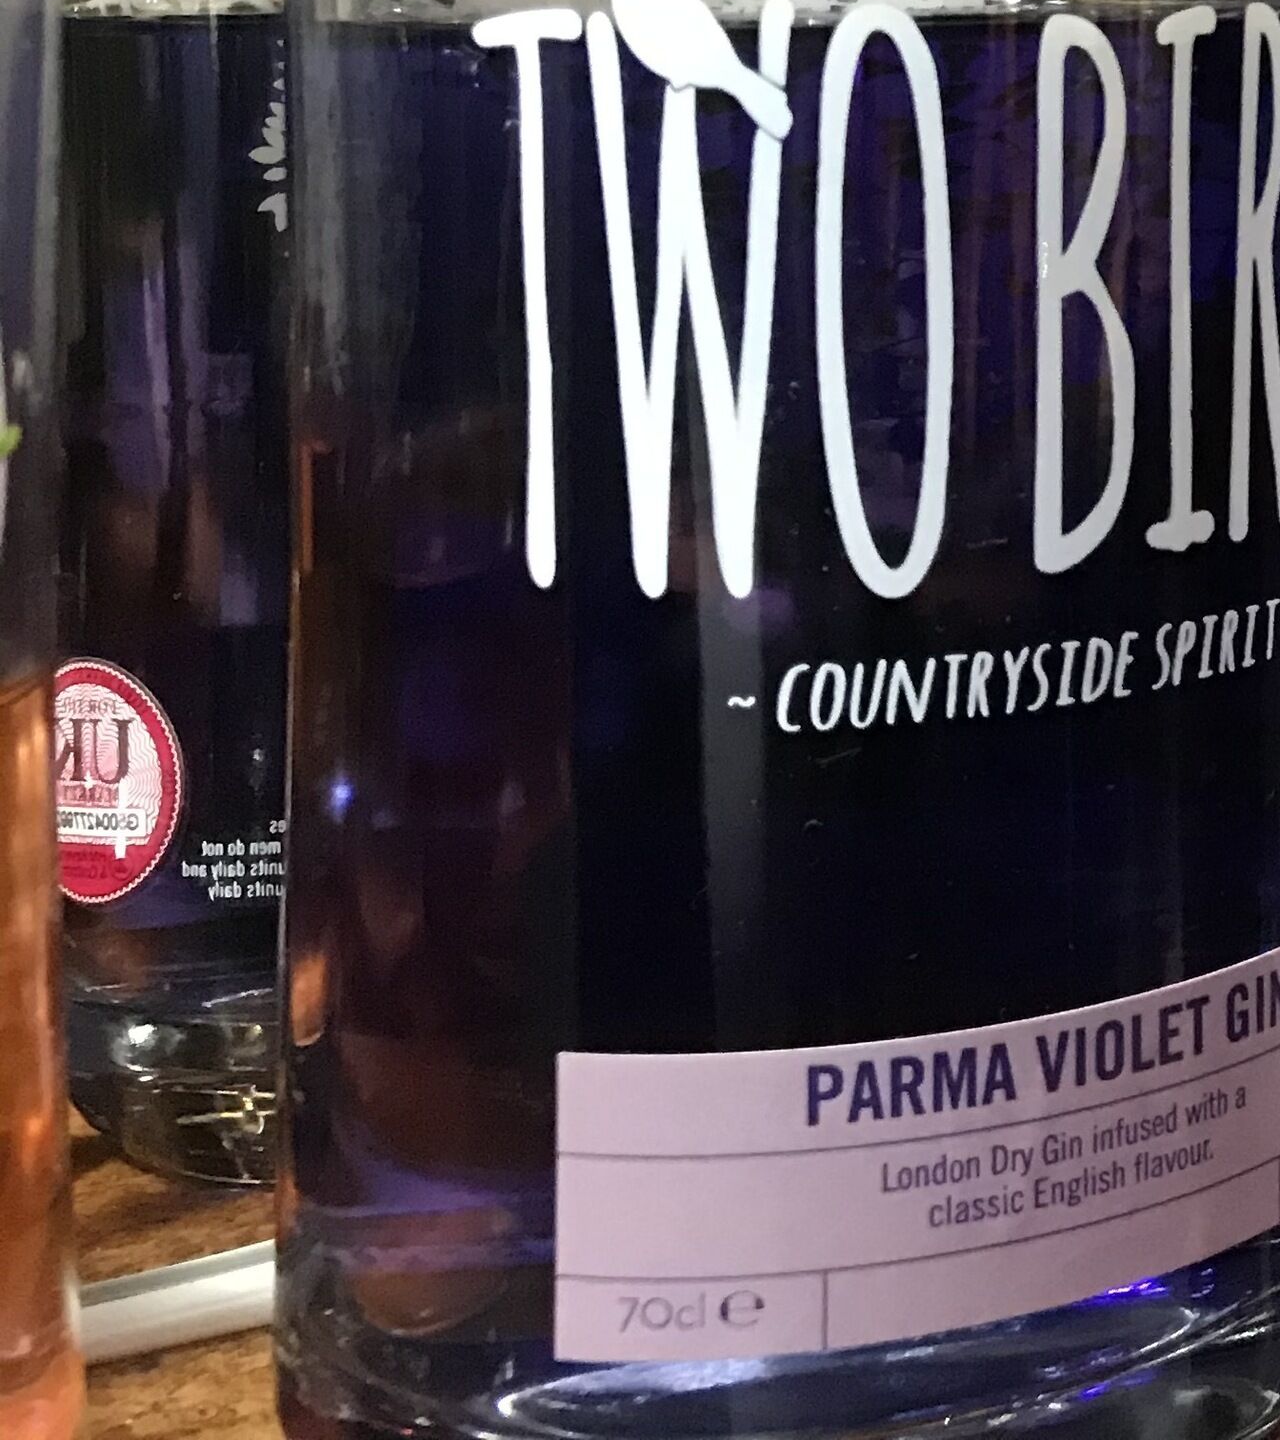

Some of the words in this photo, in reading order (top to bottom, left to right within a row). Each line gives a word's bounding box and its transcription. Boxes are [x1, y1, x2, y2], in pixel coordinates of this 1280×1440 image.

[777, 630, 1138, 733] COUNTRYSIDE
[806, 1042, 1016, 1127] PARMA
[1035, 995, 1211, 1094] VIOLET
[881, 1154, 981, 1194] London
[990, 1144, 1034, 1177] Dry
[1041, 1133, 1083, 1167] Gin
[1092, 1106, 1178, 1154] infused
[1185, 1088, 1229, 1128] with
[1234, 1086, 1247, 1110] a
[928, 1185, 1025, 1228] classic
[1033, 1164, 1126, 1208] English
[1134, 1136, 1215, 1184] flavour.
[618, 1291, 706, 1333] 70cl
